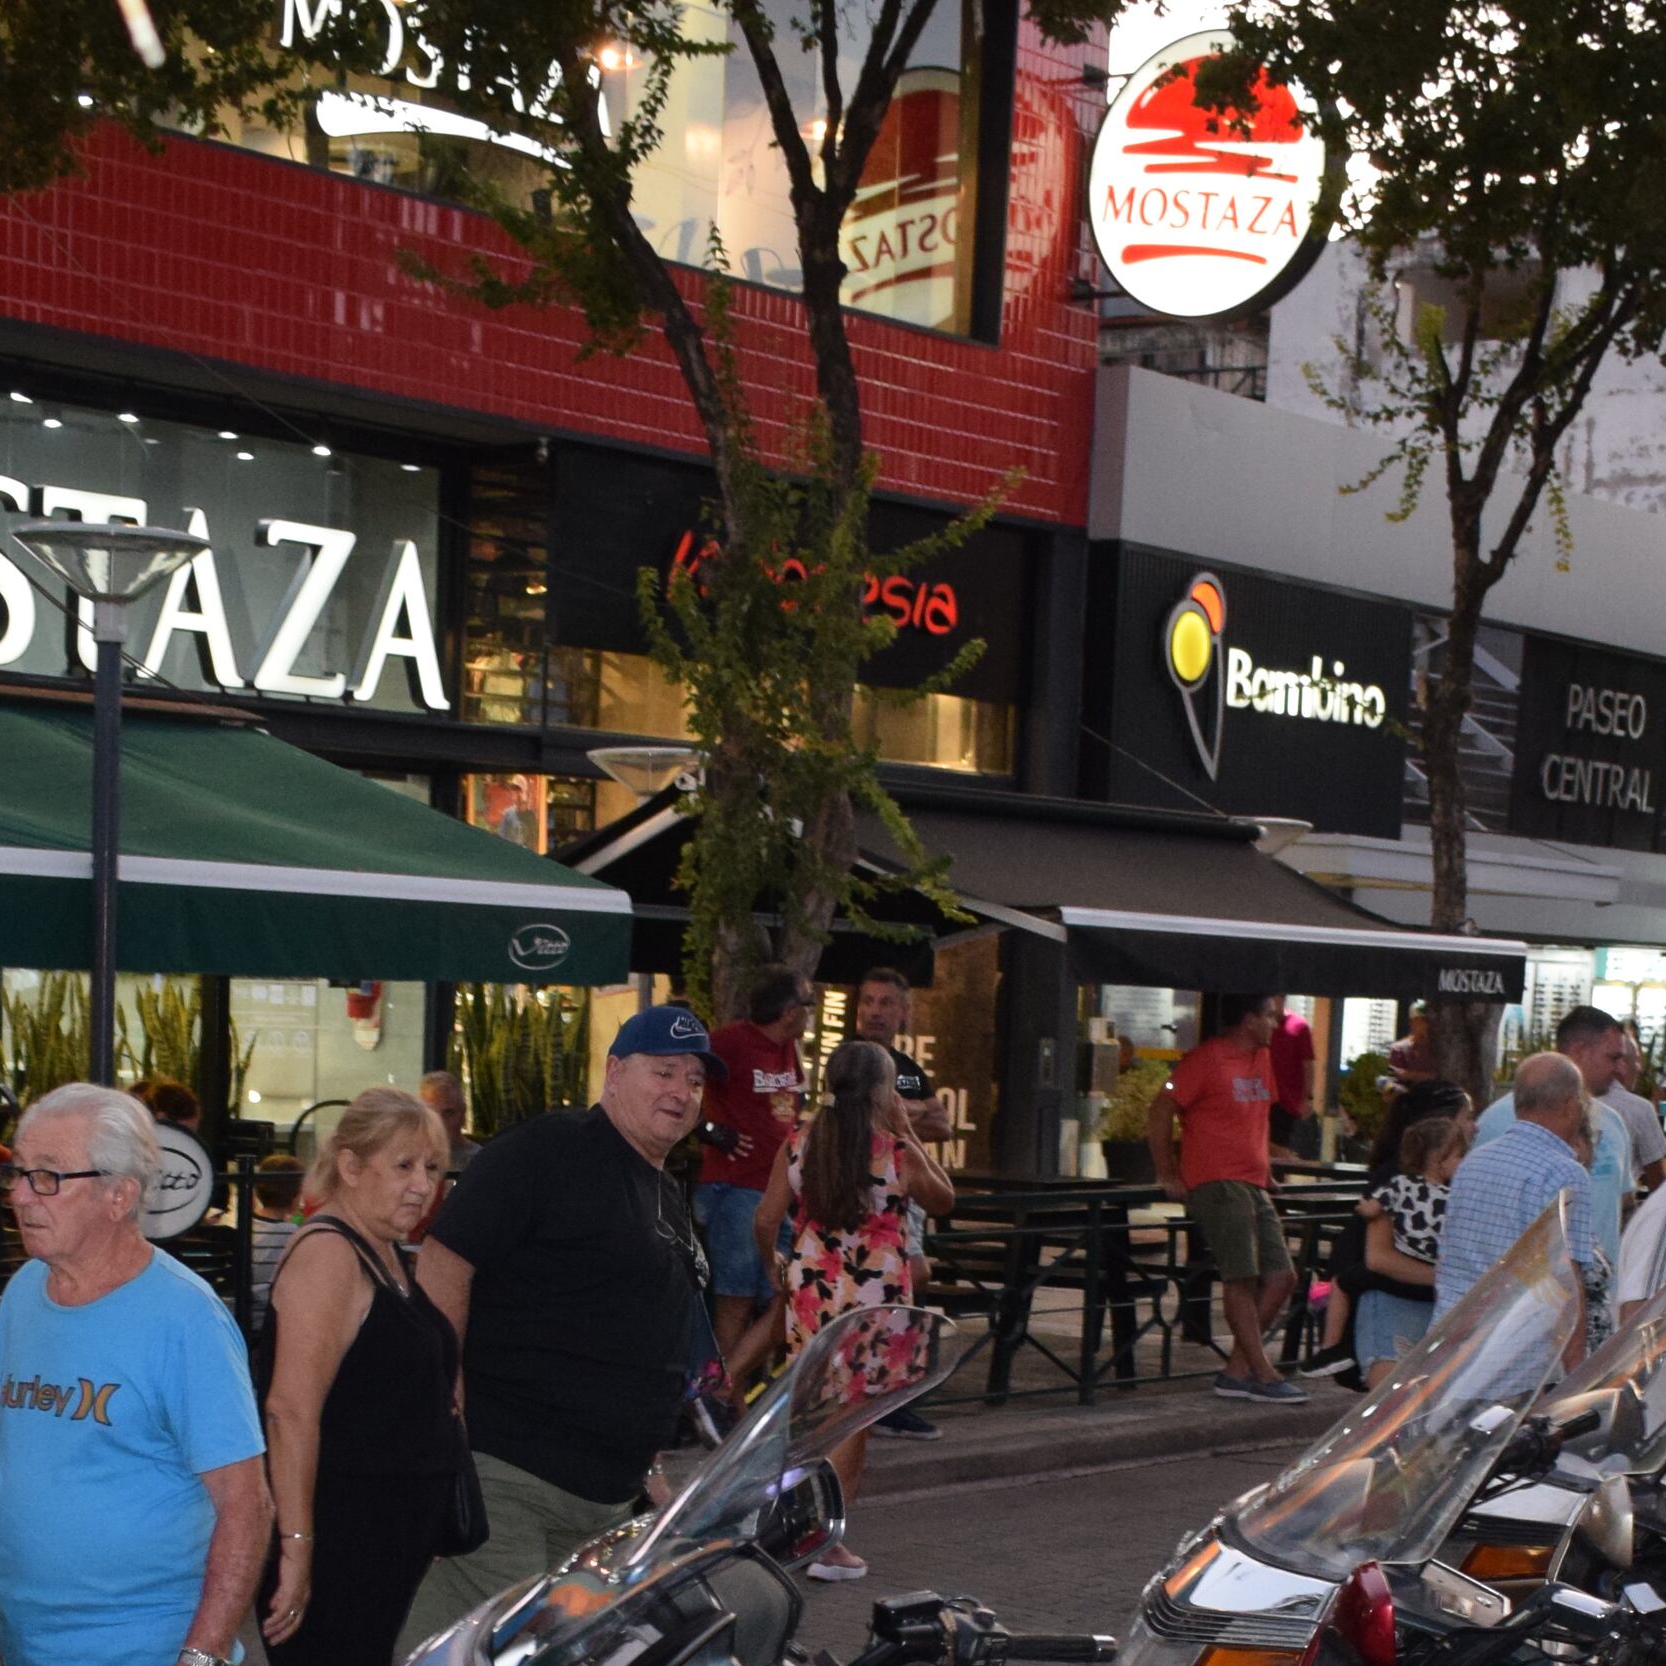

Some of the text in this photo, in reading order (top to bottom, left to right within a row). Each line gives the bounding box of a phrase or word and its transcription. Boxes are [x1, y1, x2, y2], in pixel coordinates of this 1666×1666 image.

[1103, 185, 1298, 238] MOSTAZA
[1227, 648, 1385, 728] Bambino
[1567, 684, 1646, 739] PASEO
[1542, 754, 1655, 813] CENTRAL
[1438, 968, 1505, 994] MOSTAZA
